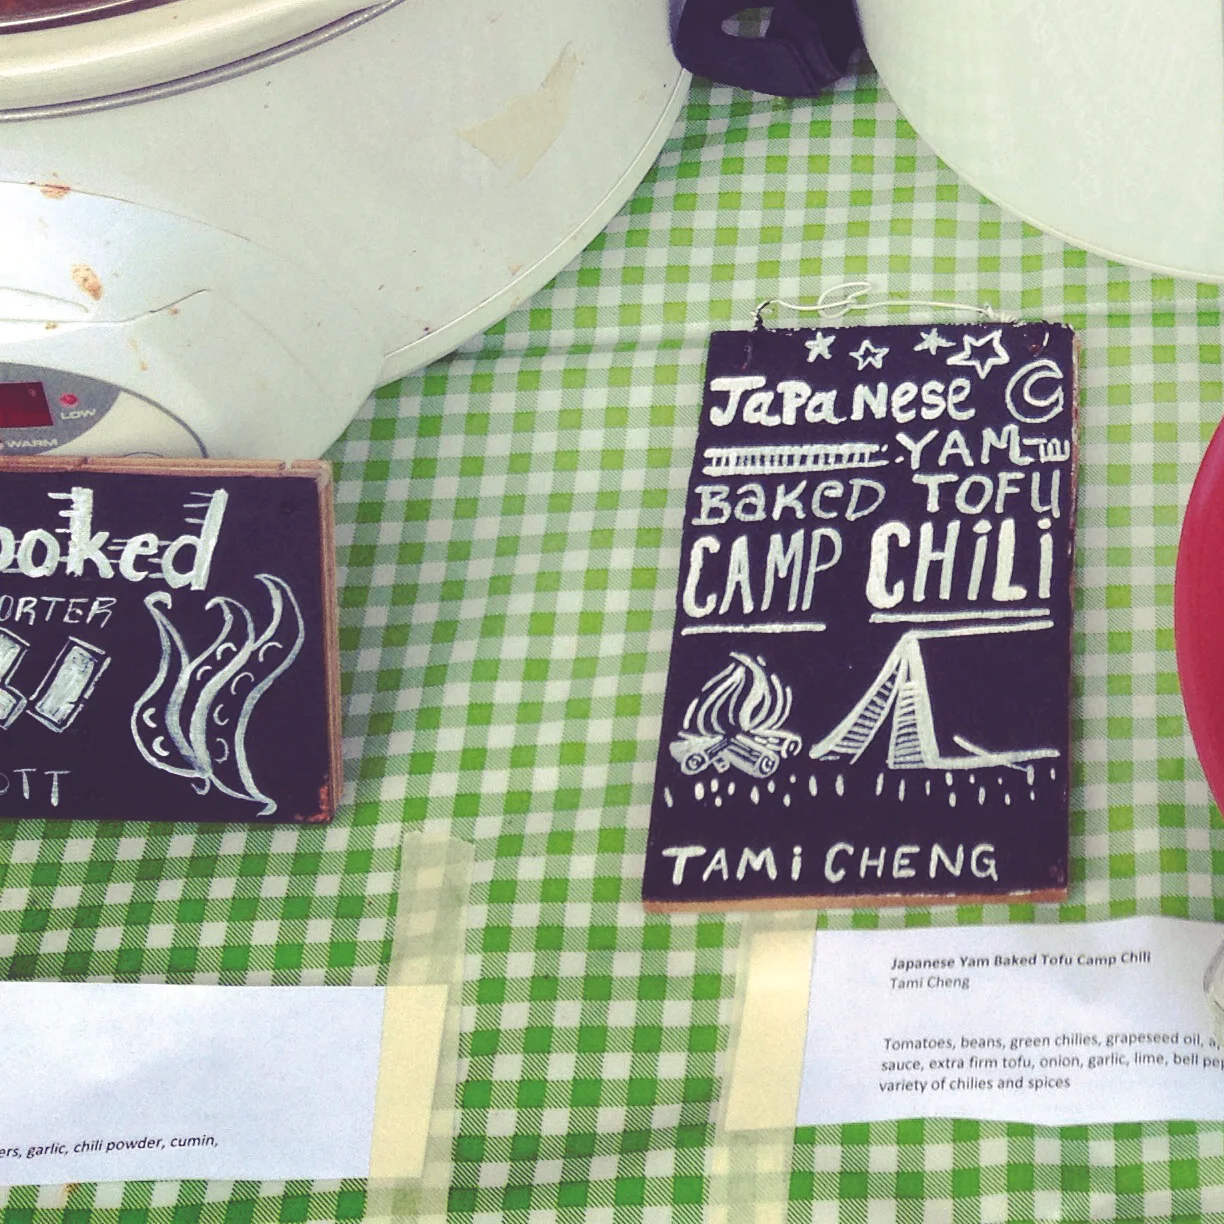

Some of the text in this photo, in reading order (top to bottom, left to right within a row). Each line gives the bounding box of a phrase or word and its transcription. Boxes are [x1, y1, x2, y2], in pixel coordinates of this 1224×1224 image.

[60, 408, 97, 420] LOW
[6, 439, 58, 448] WARM
[912, 469, 1061, 518] TOFU
[682, 526, 843, 618] CAMP
[823, 842, 999, 883] CHENG
[891, 950, 1151, 972] Japanese Yam Baked Tofu Camp Chili
[891, 975, 970, 990] Tami Cheng
[884, 1037, 956, 1051] Tomatoes,
[960, 1036, 1006, 1050] beans,
[1010, 1036, 1050, 1050] green
[1054, 1032, 1101, 1047] chilies,
[1105, 1032, 1178, 1047] grapeseed
[1183, 1033, 1204, 1048] oil,
[881, 1059, 924, 1072] sauce,
[929, 1056, 964, 1069] extra
[969, 1055, 998, 1068] firm
[1002, 1055, 1035, 1070] tofu,
[1039, 1054, 1084, 1069] onion,
[1088, 1052, 1129, 1068] garlic,
[1134, 1052, 1168, 1066] lime,
[1173, 1052, 1198, 1066] bell
[879, 1076, 1071, 1093] variety of chilies and spices
[26, 1142, 69, 1159] garlic,
[73, 1139, 103, 1154] chili
[105, 1137, 166, 1153] powder,
[170, 1134, 218, 1148] cumin,
